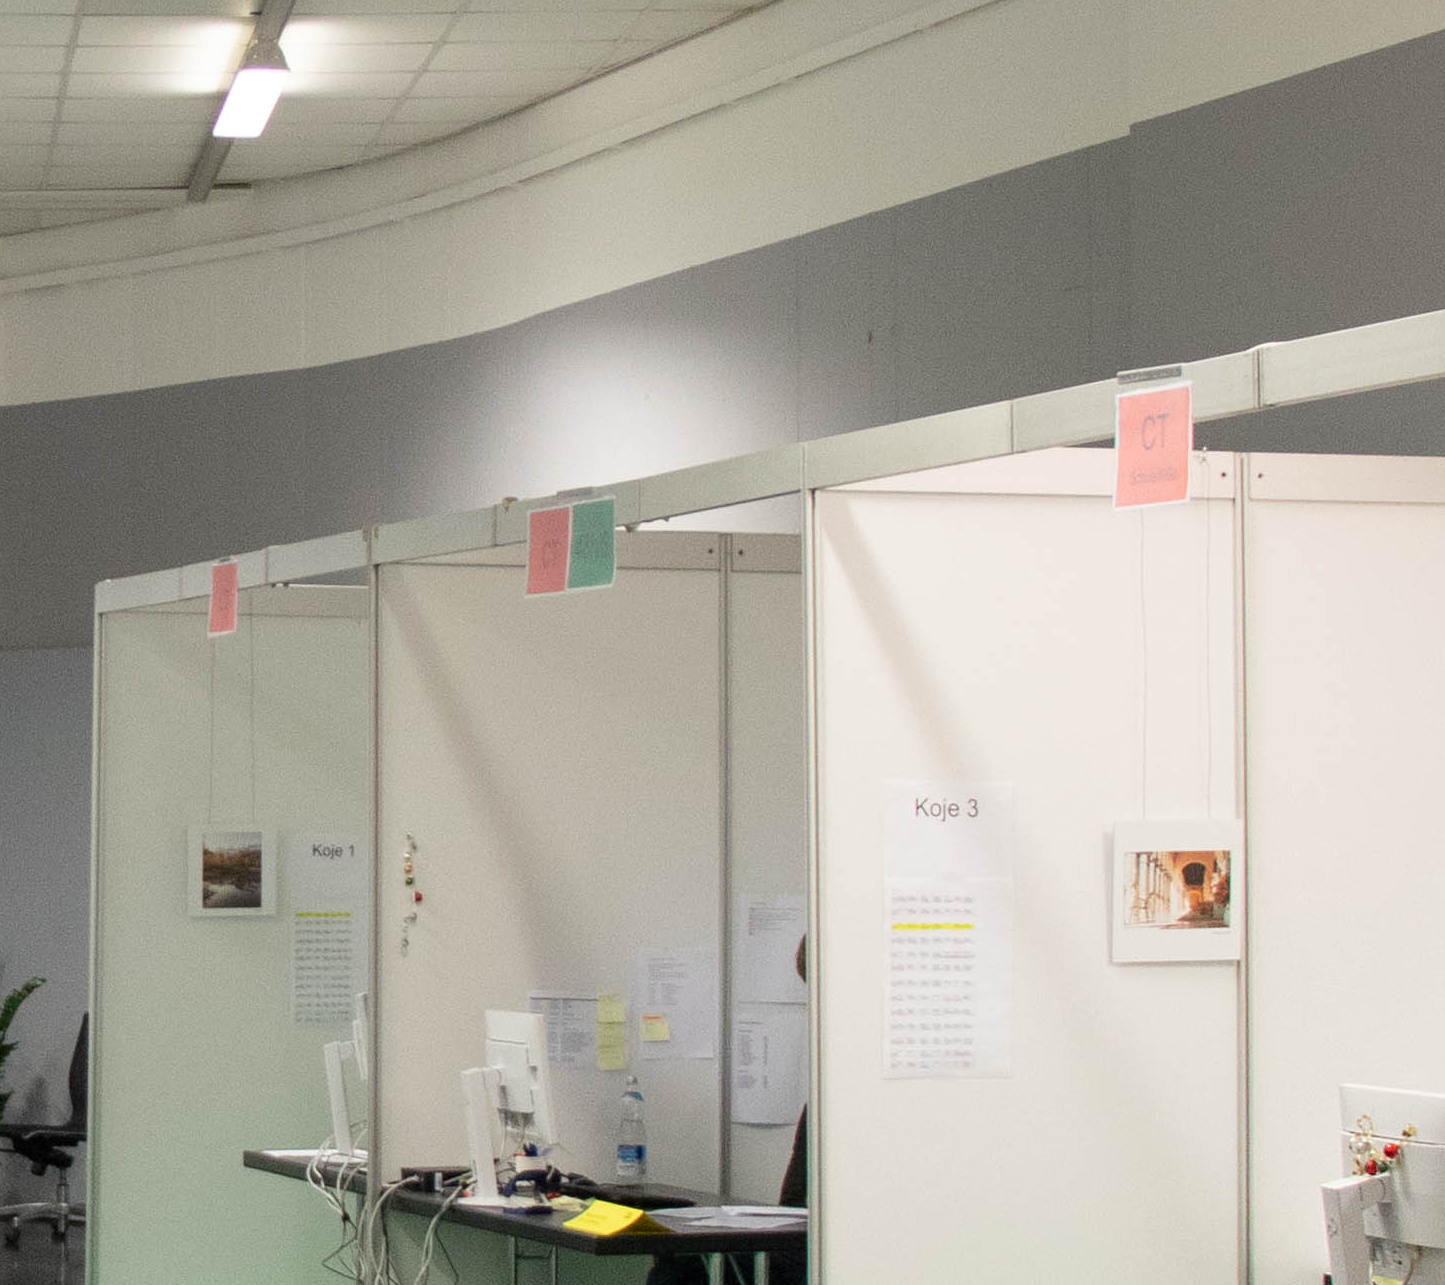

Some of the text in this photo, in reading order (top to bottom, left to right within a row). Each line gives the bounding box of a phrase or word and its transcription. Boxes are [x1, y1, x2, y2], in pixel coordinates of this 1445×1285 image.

[1141, 412, 1171, 451] CT
[914, 797, 979, 822] Koje 3
[312, 843, 355, 860] Koje 1
